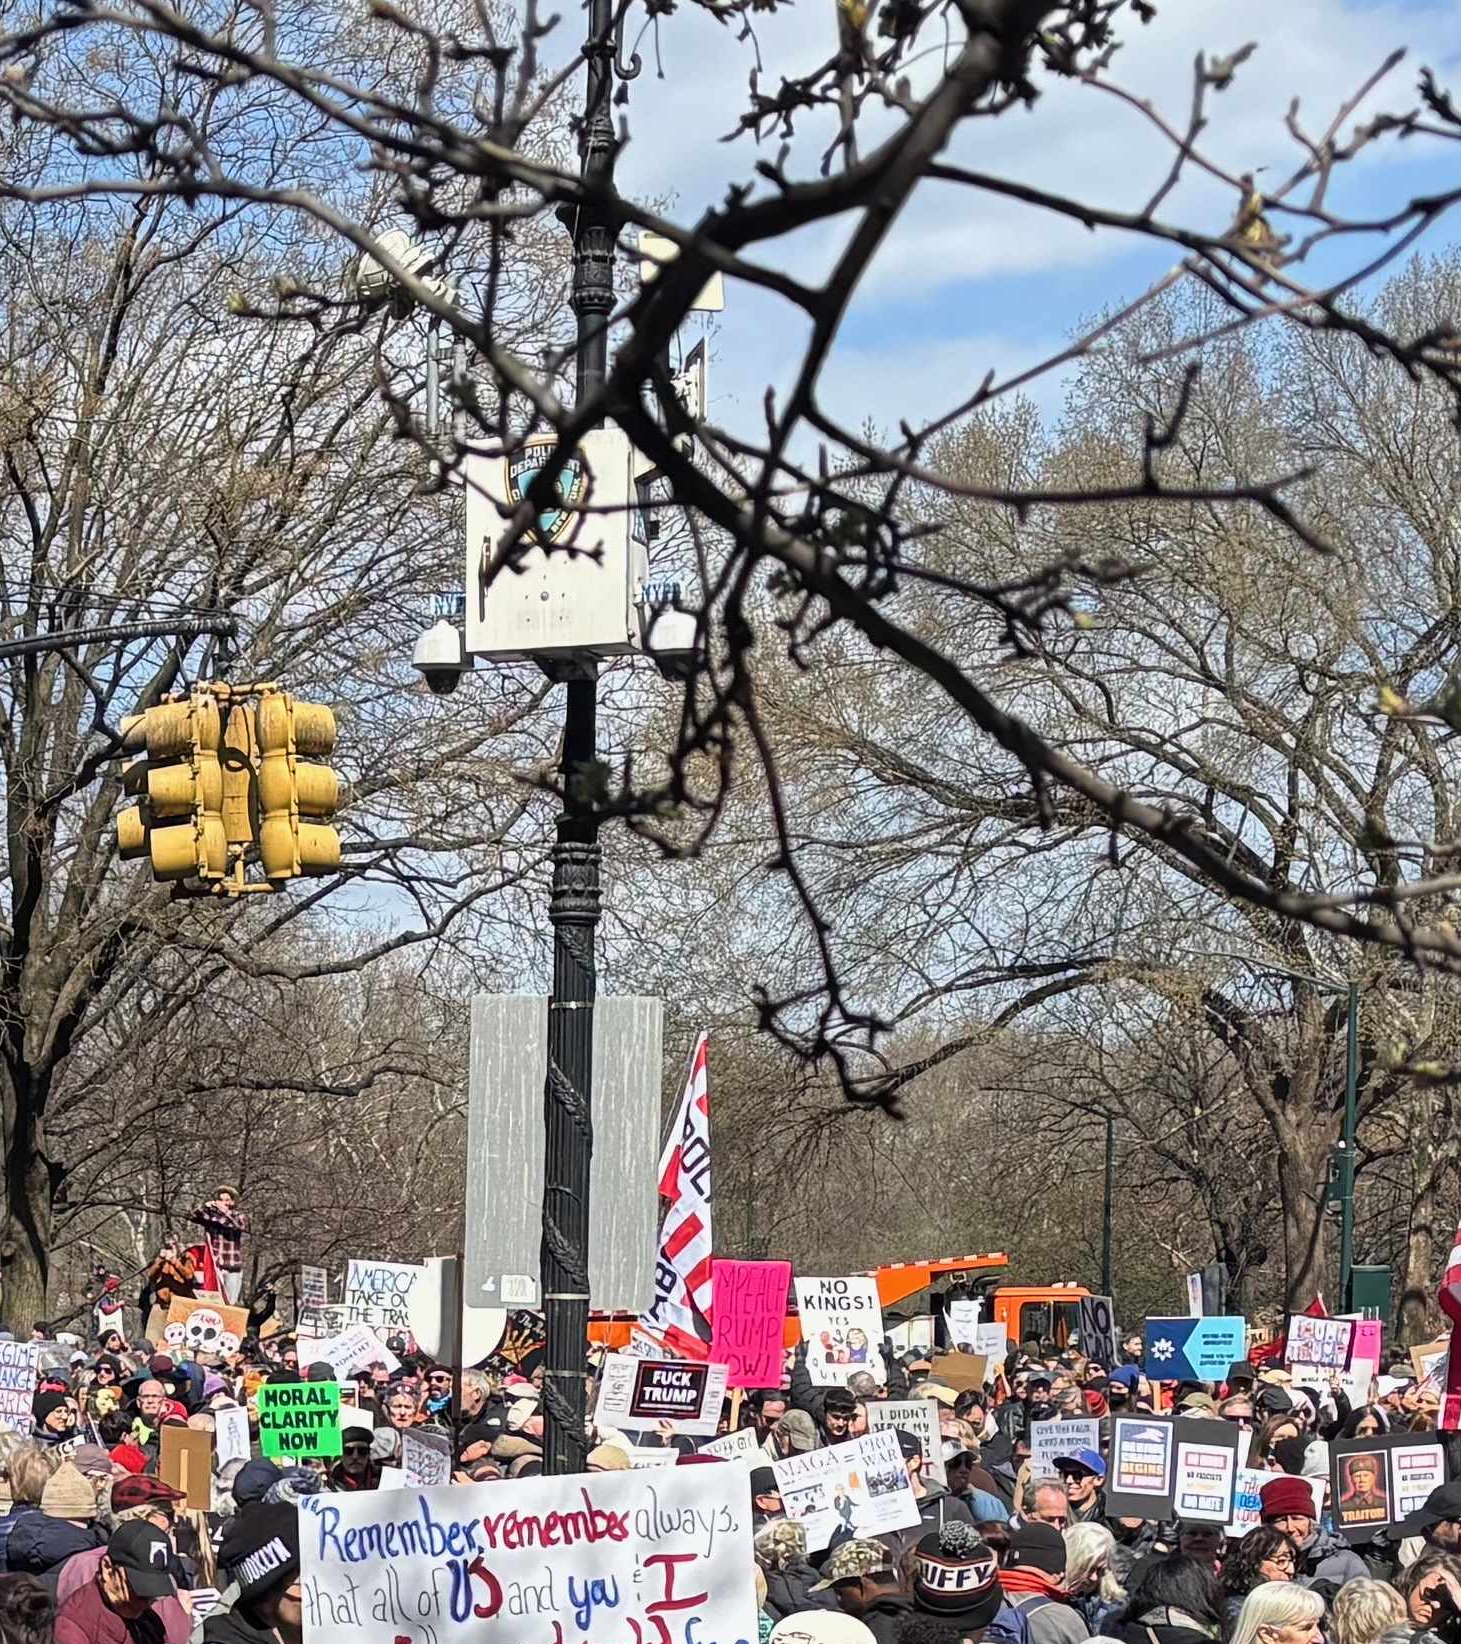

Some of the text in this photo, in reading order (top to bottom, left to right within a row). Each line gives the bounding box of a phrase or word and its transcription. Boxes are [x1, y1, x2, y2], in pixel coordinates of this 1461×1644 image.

[435, 597, 465, 616] NYP
[717, 1265, 785, 1315] MPEACH
[820, 1279, 848, 1295] NO
[351, 1289, 385, 1307] TAKE
[804, 1295, 874, 1311] KINGS!
[348, 1306, 374, 1324] THE
[828, 1316, 850, 1327] YES
[1081, 1299, 1111, 1336] NO
[719, 1315, 780, 1351] RUMP
[652, 1371, 691, 1387] FUCK
[264, 1387, 331, 1408] MORAL
[642, 1386, 698, 1403] TRUMP
[259, 1410, 339, 1430] CLARITY
[913, 1422, 931, 1433] MY
[278, 1432, 318, 1452] NOW
[777, 1451, 840, 1480] MAGA
[857, 1434, 895, 1456] PRO
[861, 1449, 899, 1468] WAR
[1121, 1461, 1165, 1476] BEGINS
[484, 1487, 630, 1550] remember
[634, 1485, 740, 1558] always,
[240, 1536, 291, 1585] OOKLYN
[921, 1563, 990, 1589] UFFY
[304, 1568, 361, 1627] that
[372, 1562, 405, 1625] all
[418, 1566, 443, 1617] of
[508, 1566, 561, 1614] and
[569, 1574, 620, 1630] you
[644, 1553, 709, 1614] I
